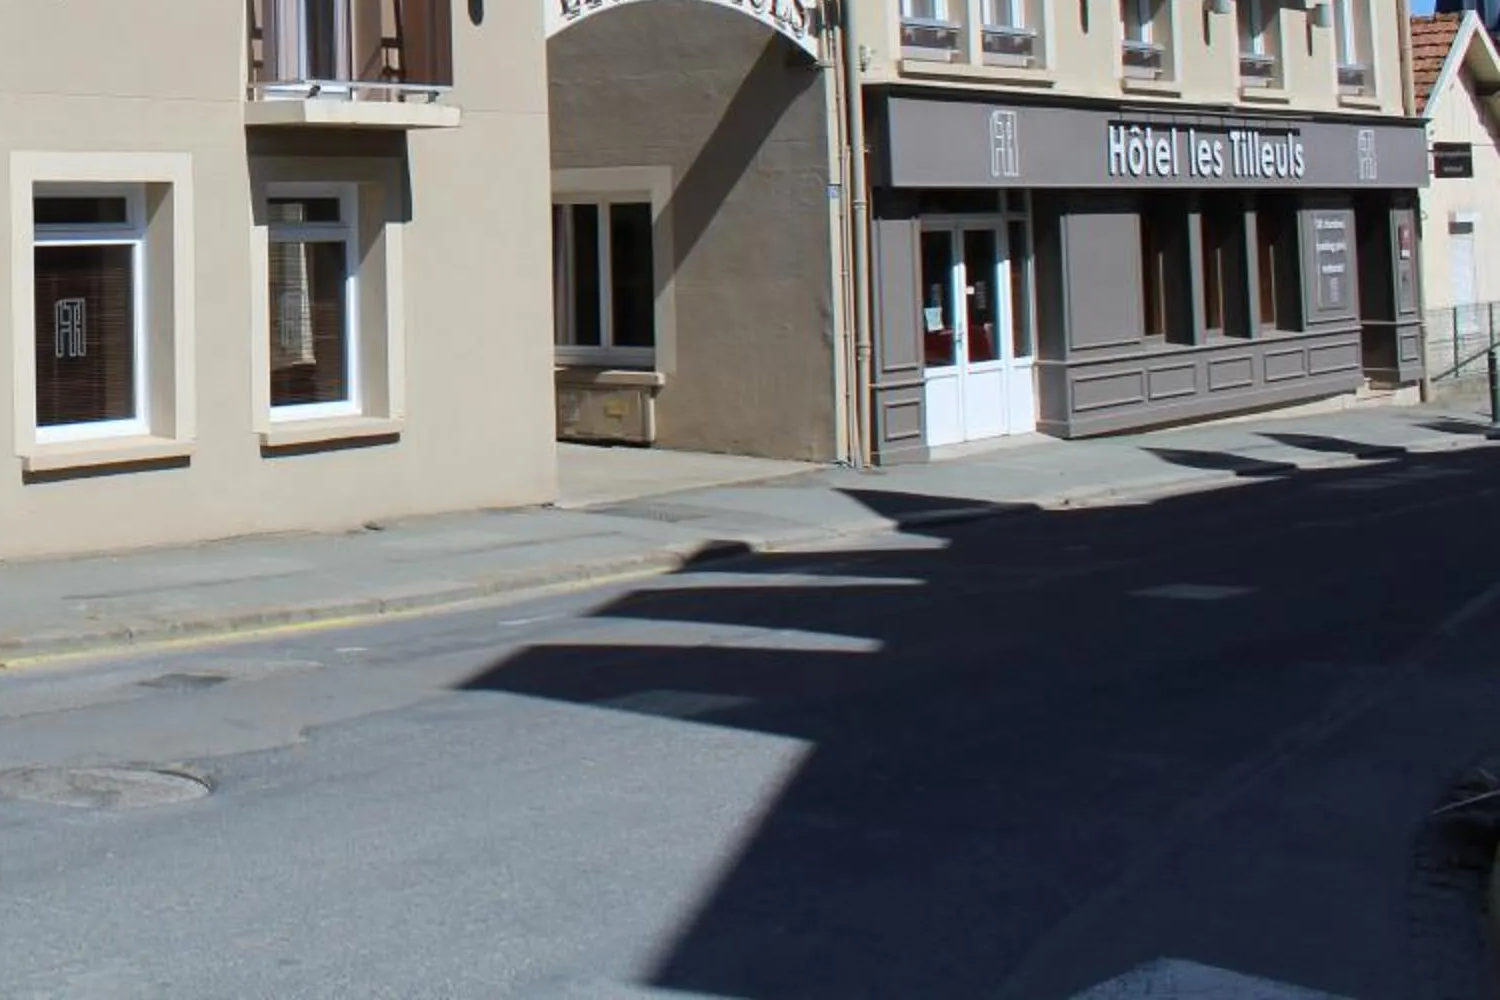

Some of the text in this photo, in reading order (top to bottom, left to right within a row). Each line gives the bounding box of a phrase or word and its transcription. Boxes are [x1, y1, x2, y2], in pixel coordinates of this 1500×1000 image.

[1109, 125, 1179, 177] Hôtel
[1189, 127, 1224, 178] les
[1229, 129, 1305, 178] Tilleuls
